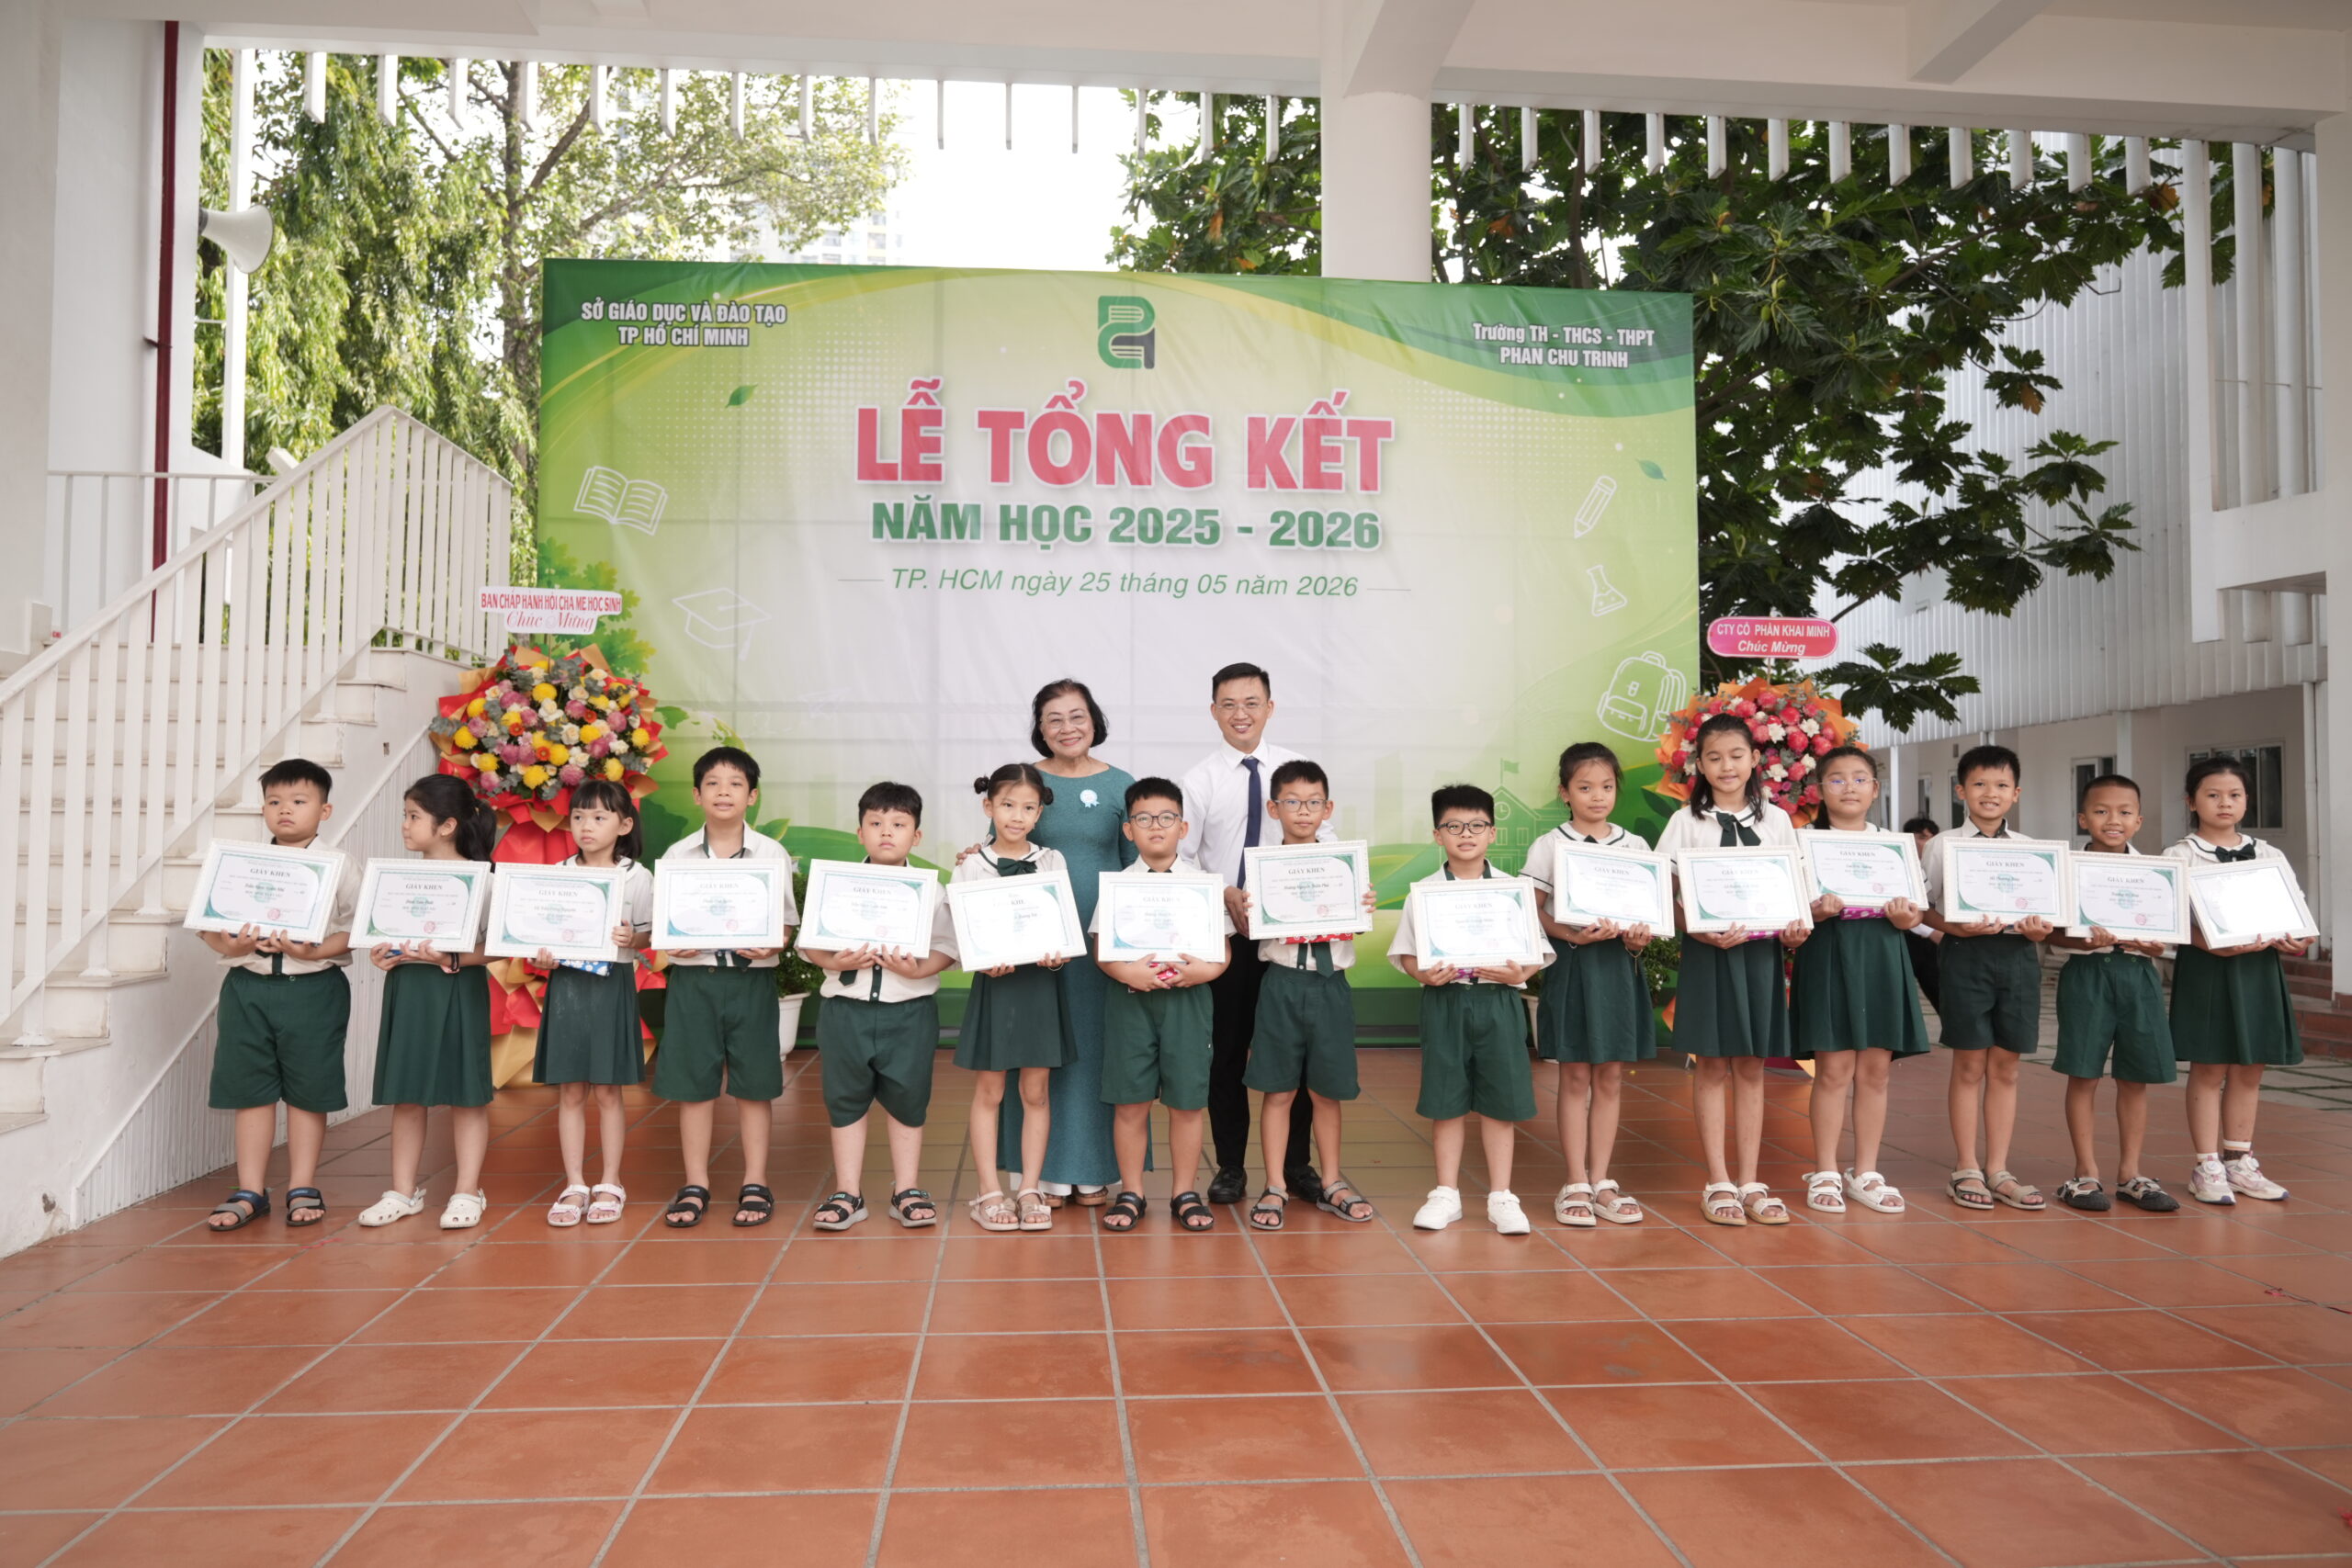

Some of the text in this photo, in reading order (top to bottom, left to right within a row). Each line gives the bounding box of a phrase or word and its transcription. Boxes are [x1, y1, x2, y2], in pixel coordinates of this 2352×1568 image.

[581, 297, 787, 327] SỞ GIÁO DỤC VÀ ĐÀO TẠO
[618, 321, 750, 346] TP HỒ CHÍ MINH
[1473, 322, 1525, 343] Trường
[1529, 324, 1548, 343] TH
[1563, 326, 1602, 344] THCS
[1616, 329, 1655, 346] THPT
[1499, 346, 1629, 368] PHAN CHU TRINH
[856, 378, 1394, 492] LỄ TỔNG KẾT
[871, 494, 982, 541] NĂM
[999, 504, 1093, 551] HỌC
[1109, 507, 1221, 546] 2025
[1269, 511, 1380, 549] 2026
[891, 568, 1359, 598] TP. HCM ngày 25 tháng 05 năm 2026
[481, 592, 498, 609] BAN
[559, 595, 574, 611] CHA
[605, 597, 621, 612] SINH
[1717, 624, 1735, 636] CTY
[1781, 625, 1804, 637] KHAI
[1806, 626, 1830, 637] MINH
[1737, 640, 1806, 656] Chúc Mừng
